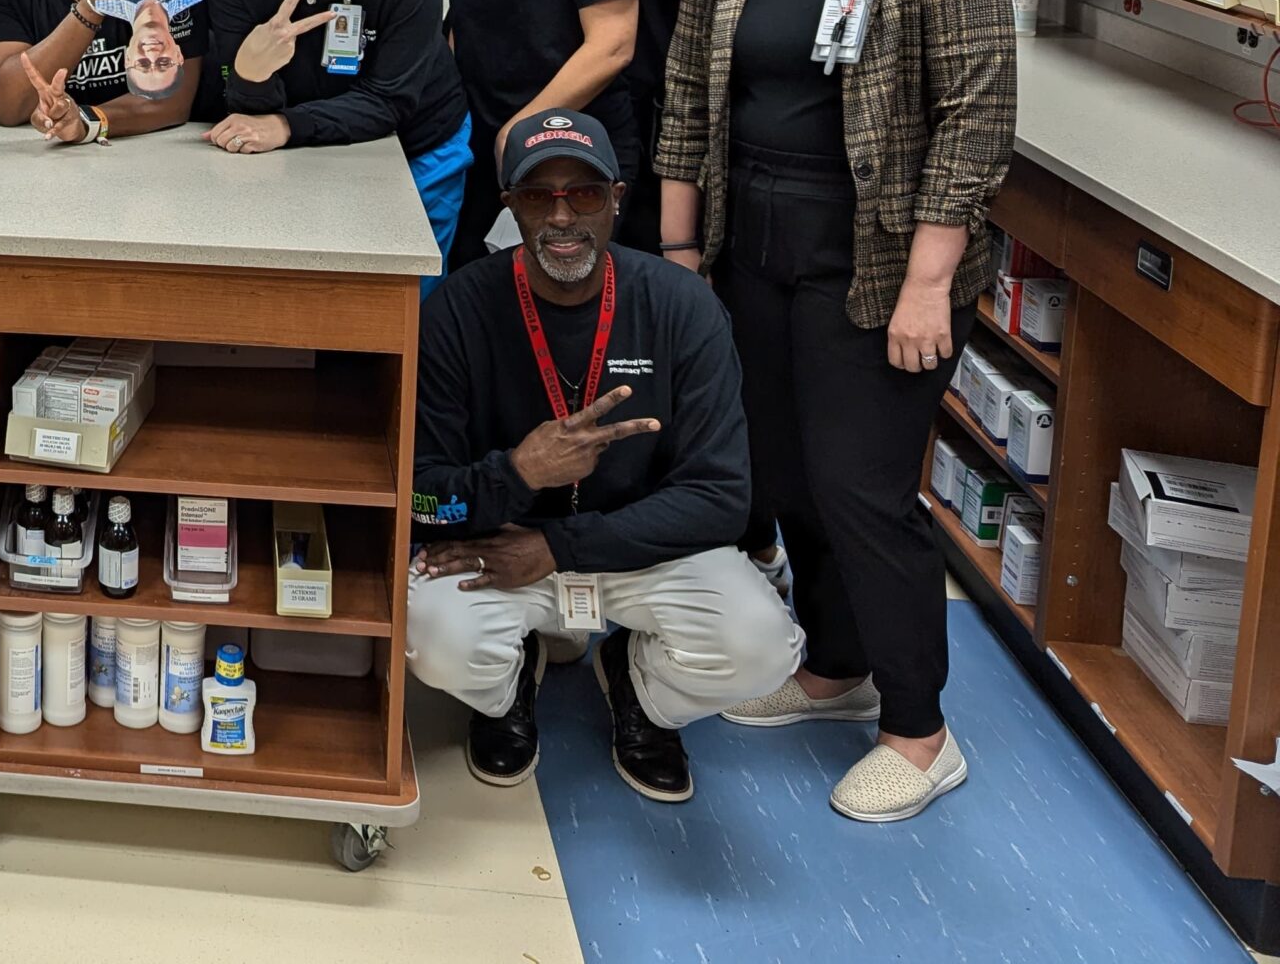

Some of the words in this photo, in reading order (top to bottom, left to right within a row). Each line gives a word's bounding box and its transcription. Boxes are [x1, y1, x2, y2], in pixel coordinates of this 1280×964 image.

[524, 129, 594, 148] GEORGIA
[517, 273, 539, 334] GEORGIA
[544, 367, 566, 419] GEORGI
